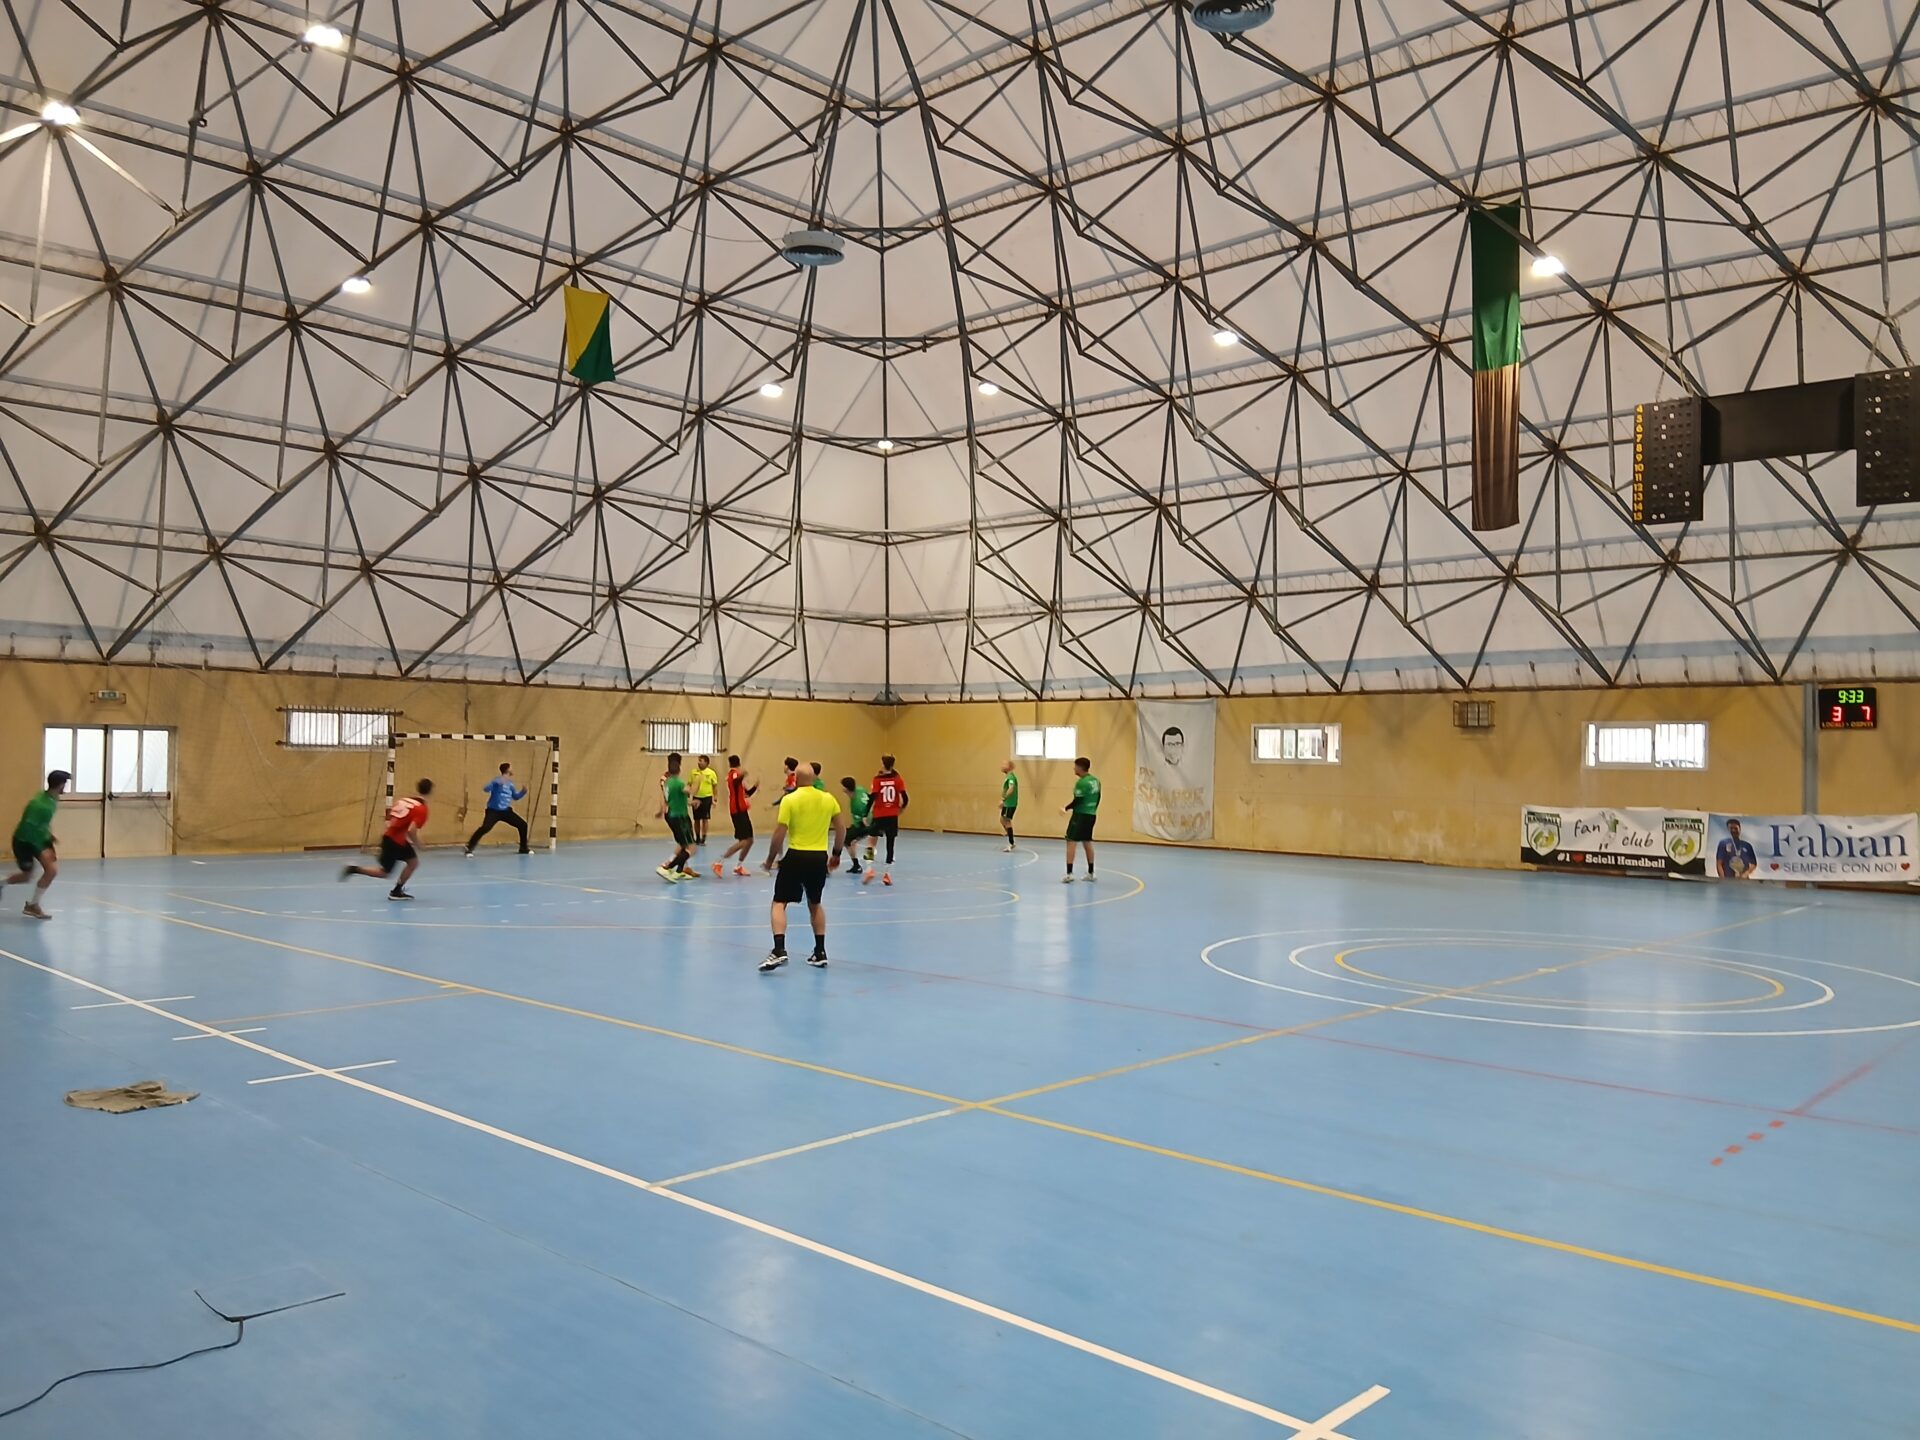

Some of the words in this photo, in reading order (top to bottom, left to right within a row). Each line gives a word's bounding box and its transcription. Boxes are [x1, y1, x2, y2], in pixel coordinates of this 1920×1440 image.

[1636, 404, 1643, 413] 4
[1636, 414, 1643, 423] 5
[1636, 424, 1643, 433] 6
[1636, 433, 1643, 443] 7
[1636, 443, 1643, 453] 8
[1636, 453, 1643, 462] 9
[1634, 463, 1644, 472] 10
[1634, 472, 1642, 482] 11
[1633, 483, 1643, 492] 12
[1633, 492, 1643, 501] 13
[1633, 502, 1643, 511] 14
[1633, 511, 1643, 521] 15
[1838, 690, 1864, 703] 9:33
[1832, 706, 1842, 722] 3
[1861, 705, 1871, 721] 7
[880, 785, 896, 803] 10
[1574, 819, 1600, 838] fan
[1665, 822, 1701, 831] HANDBALL
[1621, 832, 1654, 848] club
[1770, 823, 1909, 858] Fabian
[1557, 852, 1570, 862] #1
[1617, 855, 1666, 868] Handball
[1783, 862, 1837, 873] SEMPRE
[1841, 863, 1871, 872] CON
[1874, 863, 1897, 874] NOI
